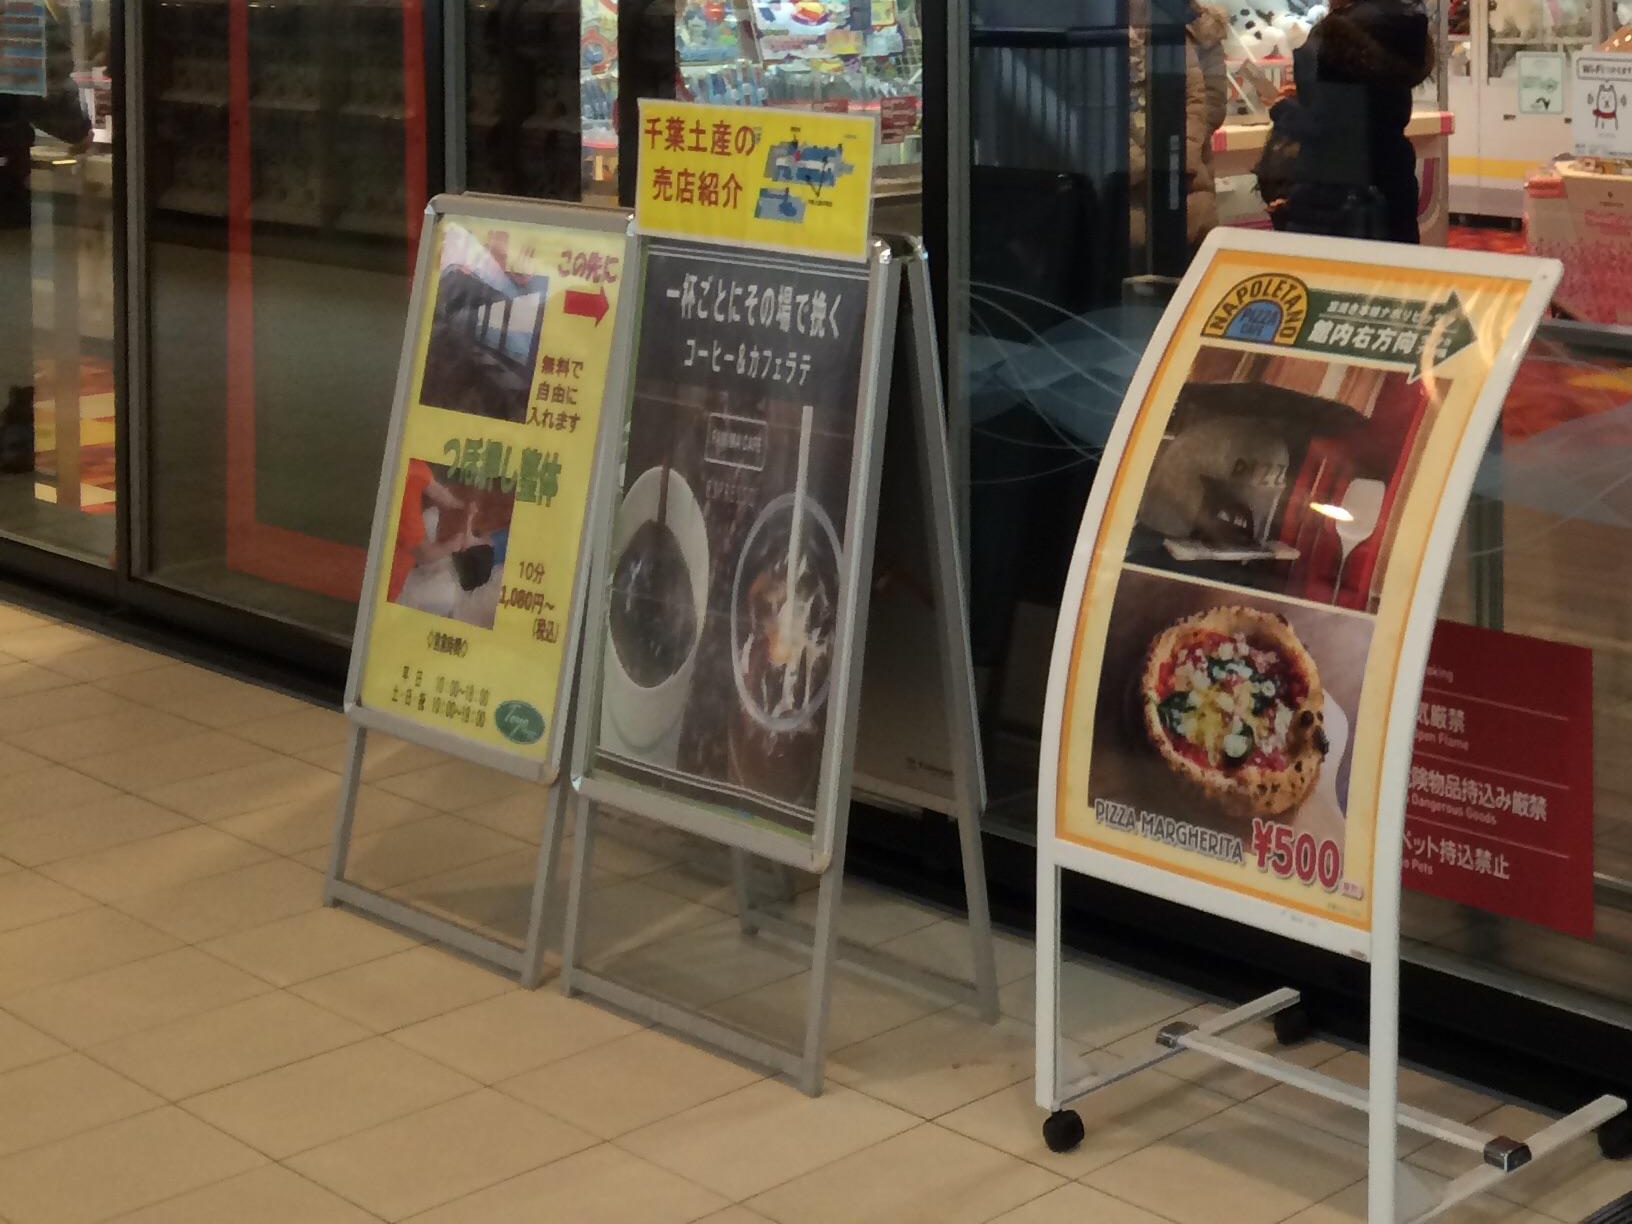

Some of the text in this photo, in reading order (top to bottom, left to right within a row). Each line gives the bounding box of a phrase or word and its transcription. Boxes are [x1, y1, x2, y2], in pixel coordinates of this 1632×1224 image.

[645, 116, 755, 157] 千葉土産の
[652, 166, 743, 210] 売店紹介
[558, 250, 619, 284] この先に
[1307, 319, 1419, 355] 館内右方向
[541, 354, 584, 380] 無料で
[535, 381, 578, 406] 自由に
[526, 406, 582, 433] 入れます
[1418, 702, 1465, 733] 気厳禁
[1409, 766, 1548, 822] 険物品持込み厳禁
[1095, 800, 1244, 863] PIZZA MARGHERITA
[1252, 818, 1341, 890] ¥500
